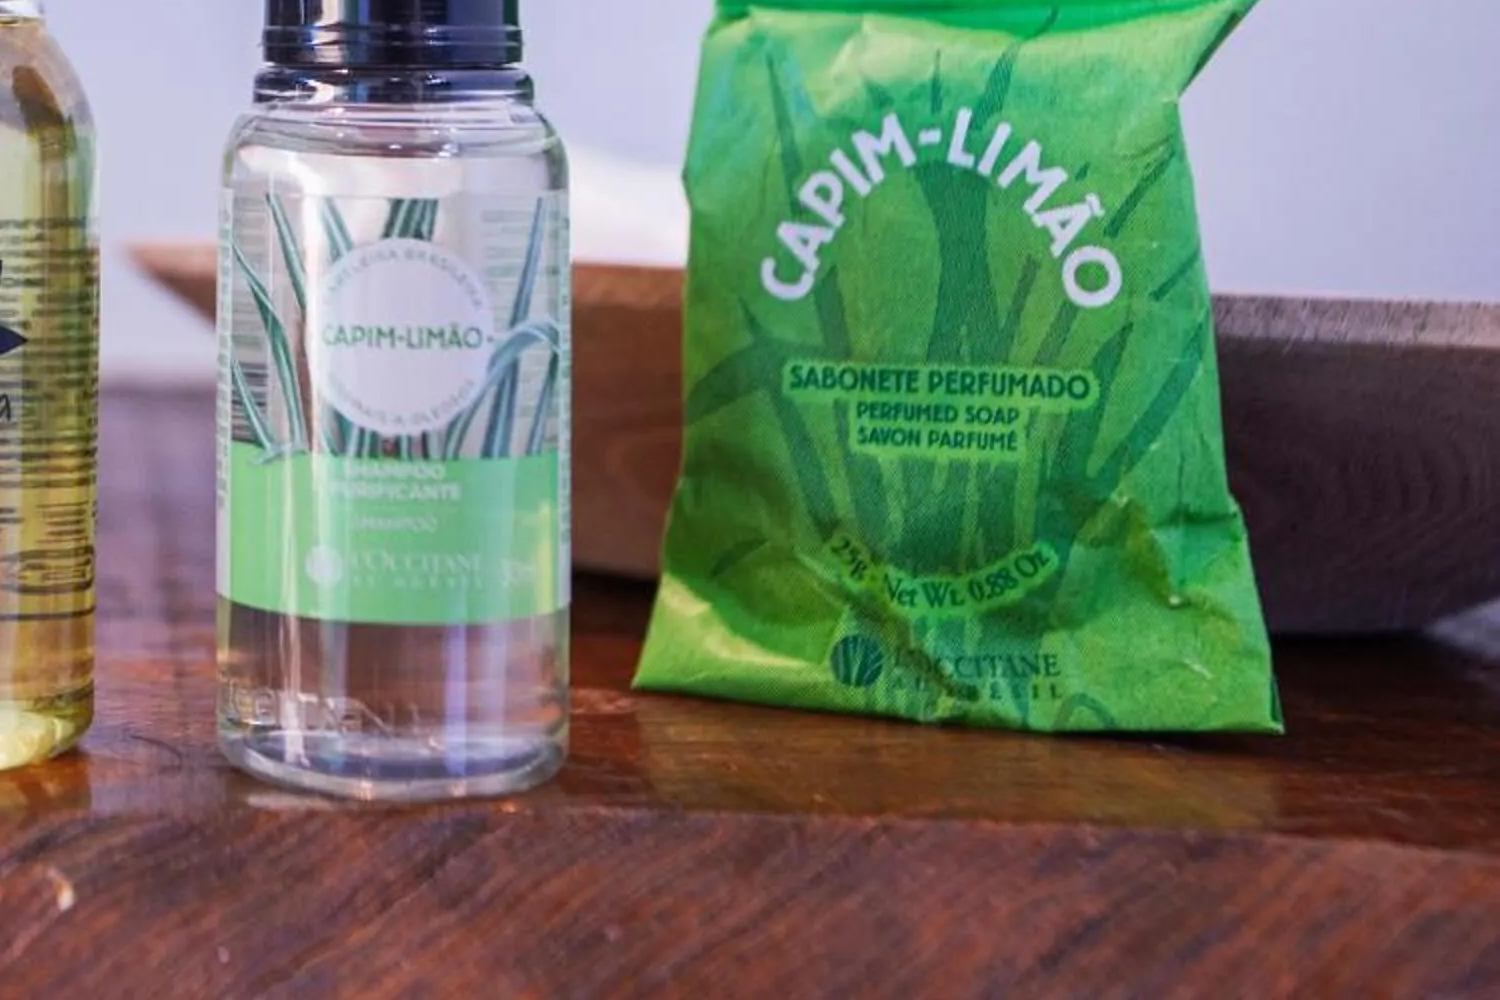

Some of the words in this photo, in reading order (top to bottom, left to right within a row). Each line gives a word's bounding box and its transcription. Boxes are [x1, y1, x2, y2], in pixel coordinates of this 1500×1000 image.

[761, 108, 1122, 308] CAPIM-LIMÃO
[790, 364, 920, 394] SABONETE
[928, 369, 1091, 400] PERFUMADO
[856, 402, 959, 424] PERFUMED
[965, 404, 1020, 426] SOAP
[857, 426, 922, 448] SAVON
[928, 429, 1019, 451] PARFUMÉ
